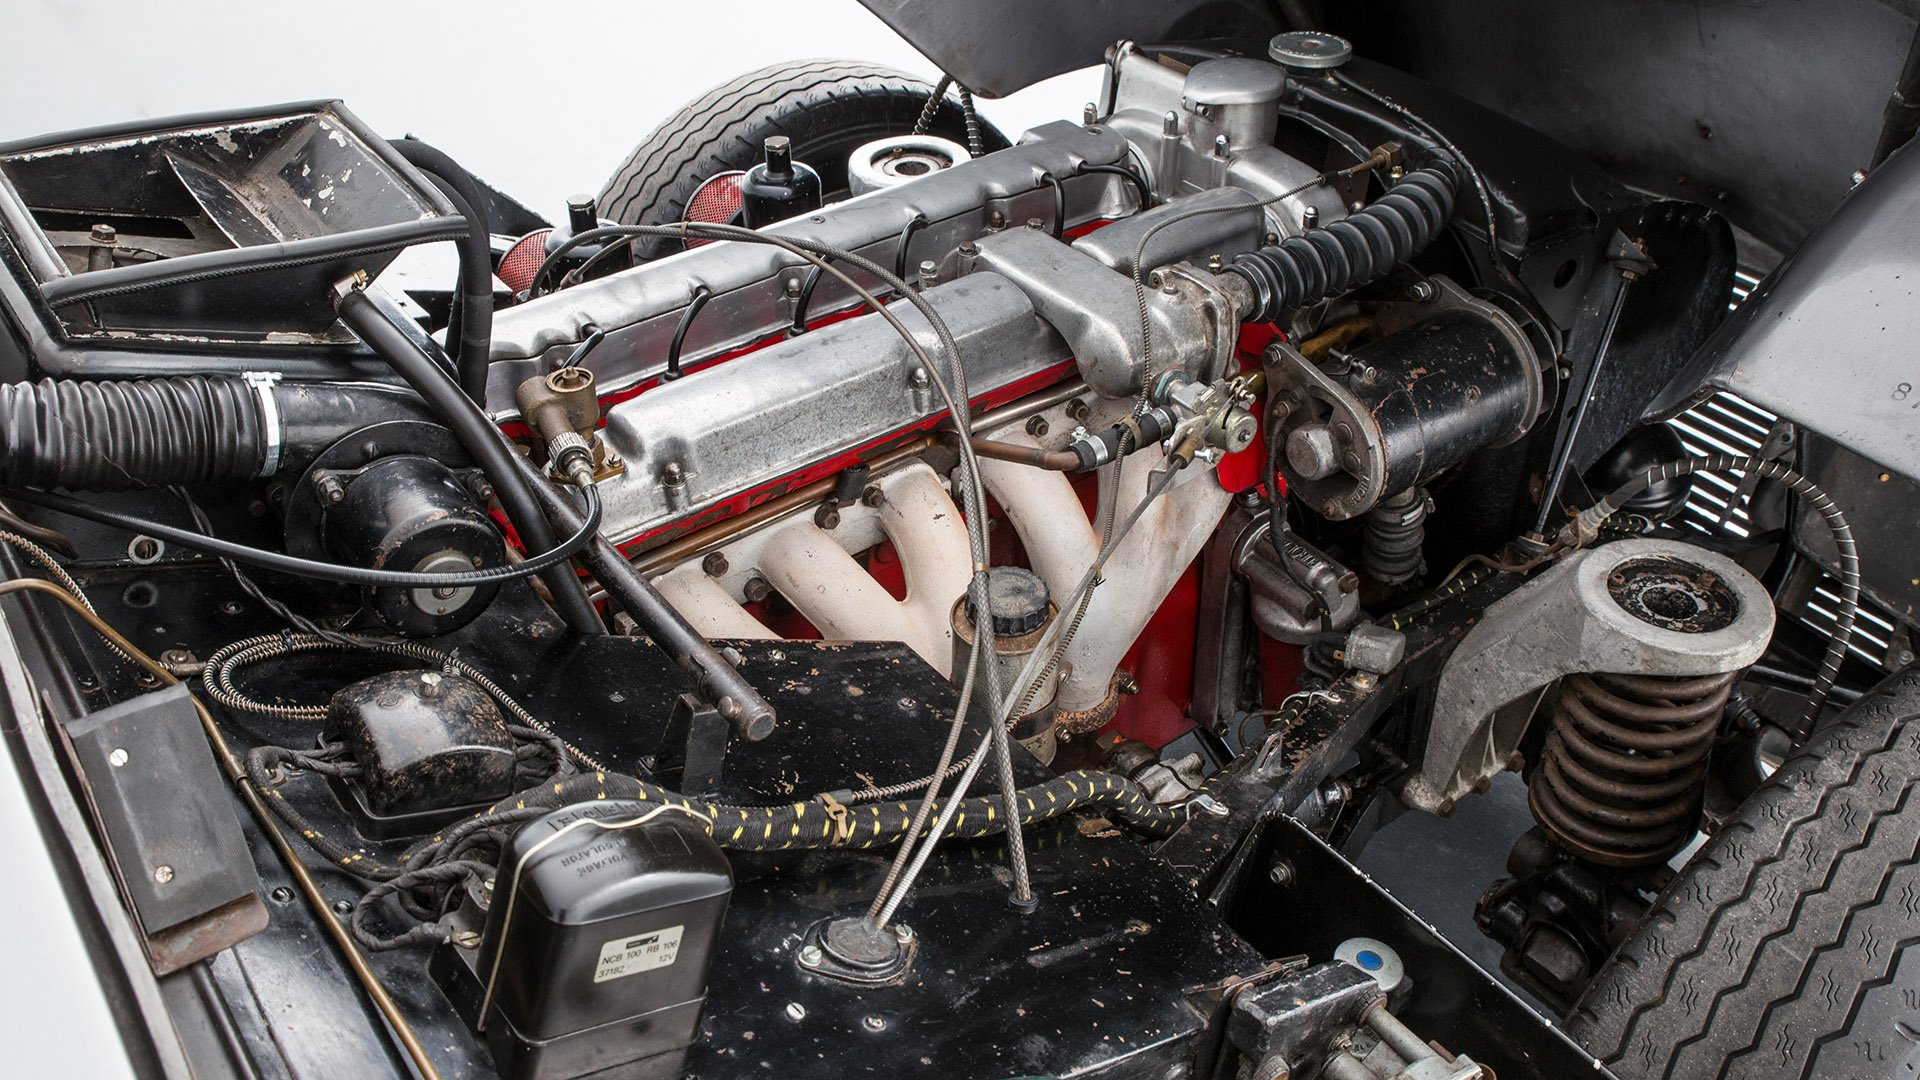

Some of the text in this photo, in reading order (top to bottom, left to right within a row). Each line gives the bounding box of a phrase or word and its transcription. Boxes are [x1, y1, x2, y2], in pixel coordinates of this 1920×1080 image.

[1350, 473, 1370, 506] LUCAS
[598, 952, 675, 978] 37182 12V
[602, 953, 623, 965] NCB
[627, 949, 642, 960] 100
[646, 944, 660, 954] RB
[663, 939, 678, 950] 106
